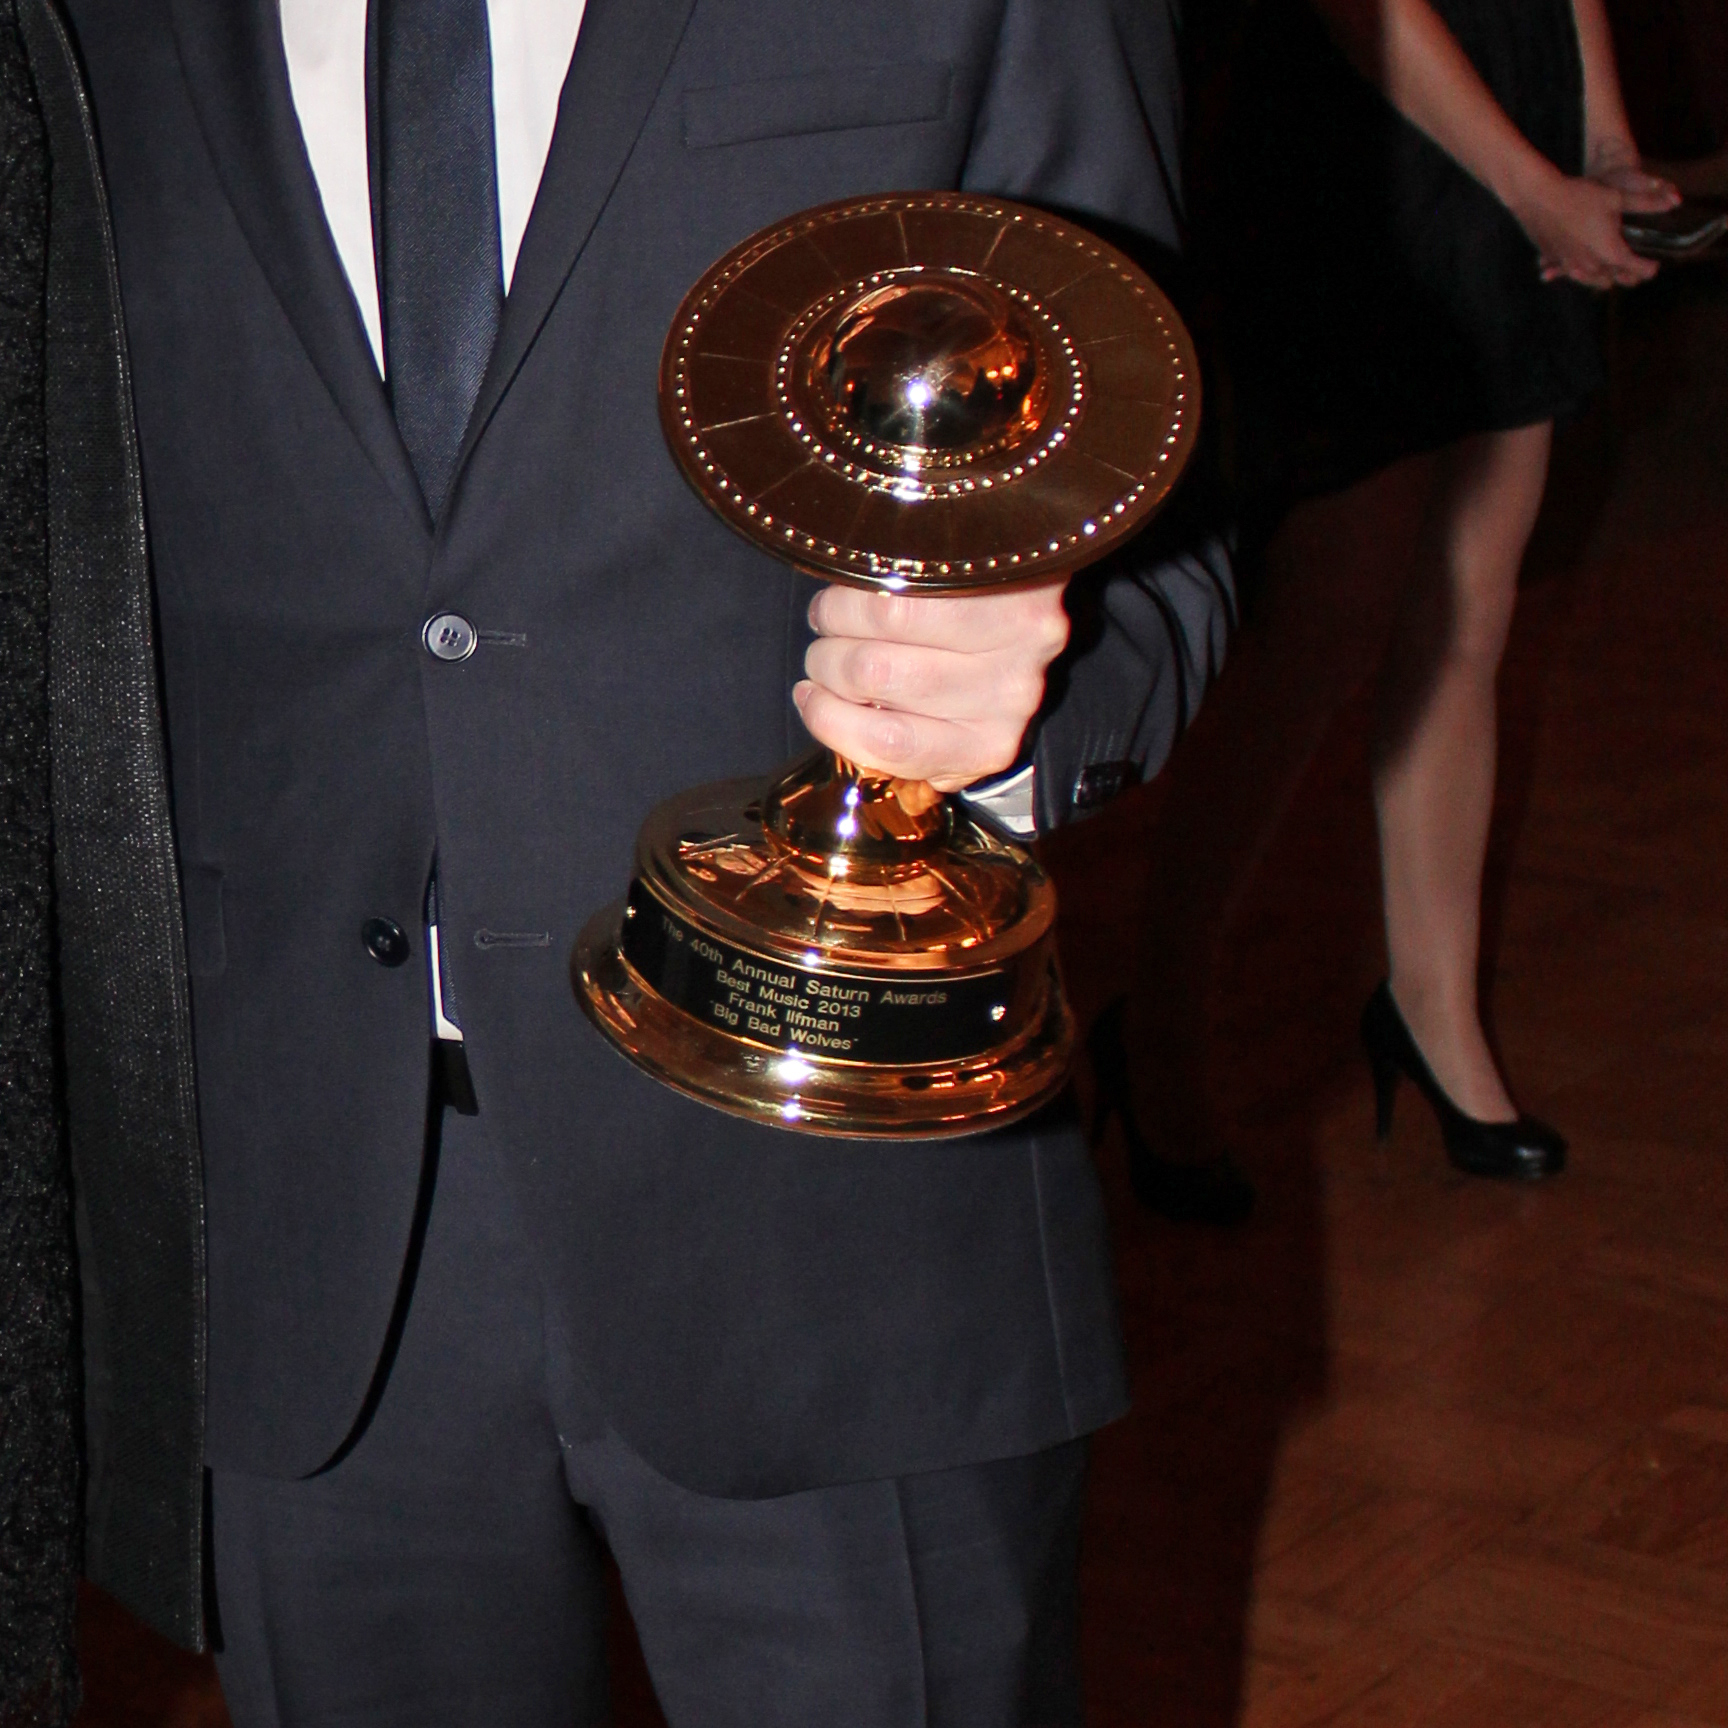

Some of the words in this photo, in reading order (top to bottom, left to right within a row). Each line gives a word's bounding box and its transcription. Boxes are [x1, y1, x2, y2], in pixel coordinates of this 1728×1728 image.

[662, 914, 684, 942] The
[690, 938, 724, 965] 40th
[732, 958, 797, 990] Annual
[805, 979, 870, 1003] Saturn
[879, 989, 949, 1005] Awards
[716, 969, 751, 993] Best
[758, 985, 810, 1010] Music
[817, 1000, 862, 1018] 2013
[729, 991, 778, 1019] Frank
[785, 1008, 840, 1032] Ilfman
[747, 1015, 782, 1037] Bad
